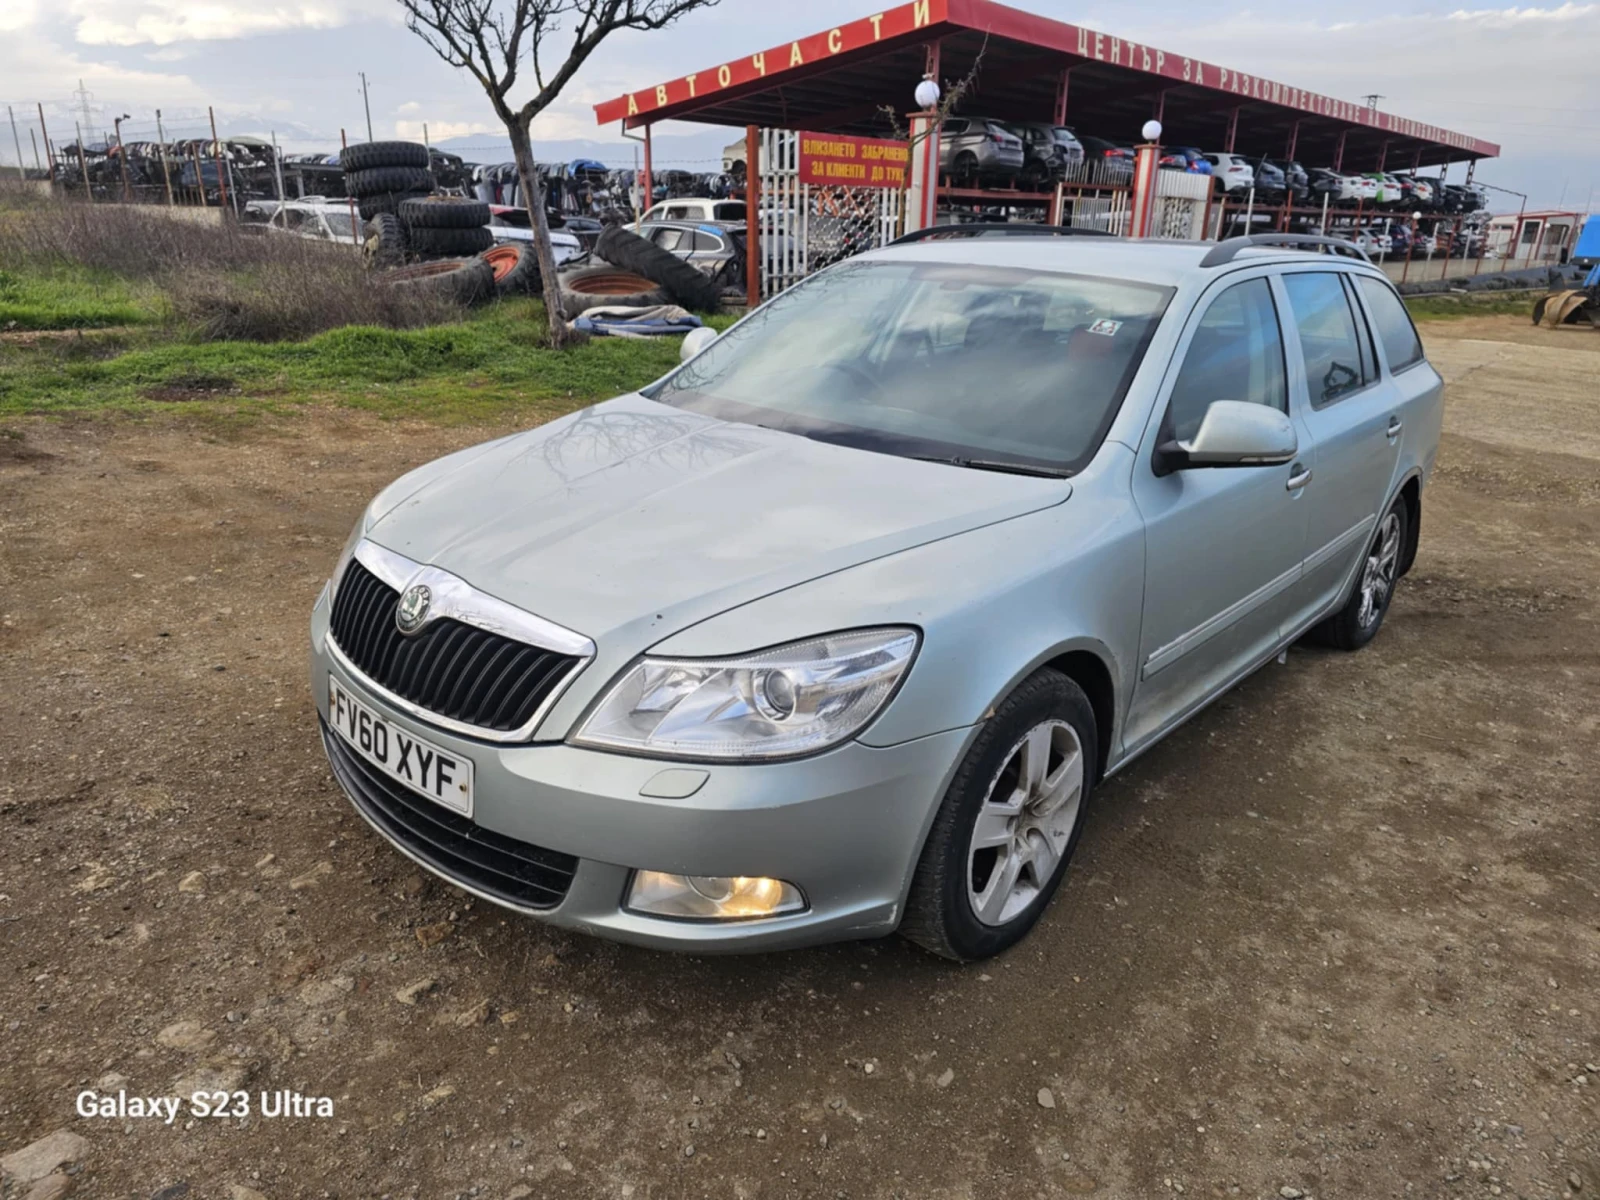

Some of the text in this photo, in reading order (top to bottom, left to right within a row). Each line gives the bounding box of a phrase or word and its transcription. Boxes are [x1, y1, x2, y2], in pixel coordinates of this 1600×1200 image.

[627, 0, 930, 116] АВТОЧАСТИ
[1077, 28, 1165, 75] ЦЕНТЪР
[1183, 58, 1203, 84] ЗА
[1220, 68, 1361, 122] РАЗКОМПЛЕКТОВАНЕ
[803, 139, 909, 162] ВЛИЗАНЕТО ЗАБРАНЕНО
[812, 160, 824, 176] ЗА
[826, 162, 865, 178] КЛИЕНТИ
[871, 165, 884, 182] ДО
[336, 688, 456, 797] FV60 XYF
